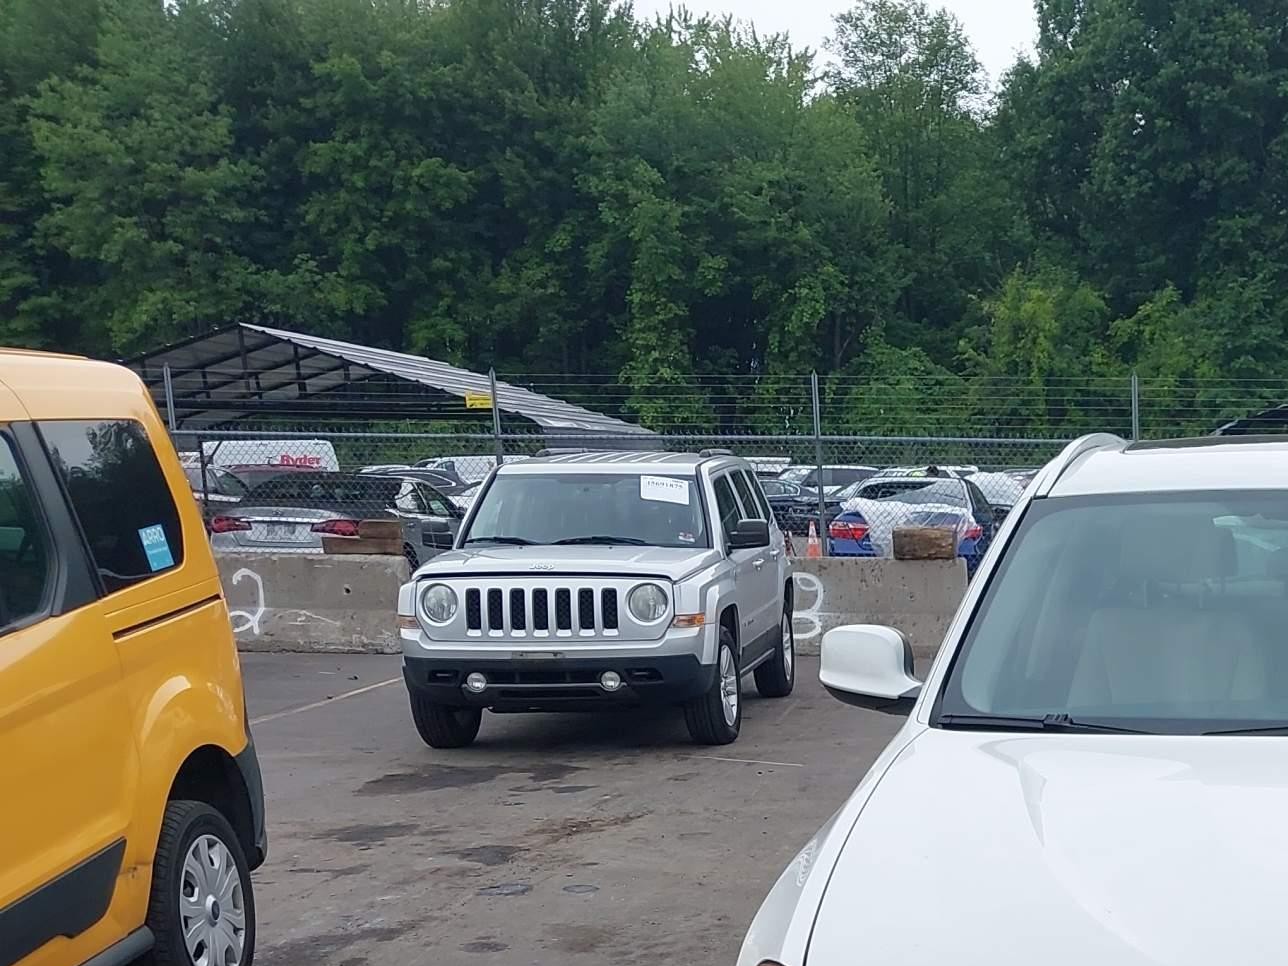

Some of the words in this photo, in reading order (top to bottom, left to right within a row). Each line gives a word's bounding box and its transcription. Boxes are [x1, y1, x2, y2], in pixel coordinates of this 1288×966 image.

[280, 454, 321, 466] Ryder
[529, 561, 555, 571] Jeep
[229, 568, 266, 635] 2
